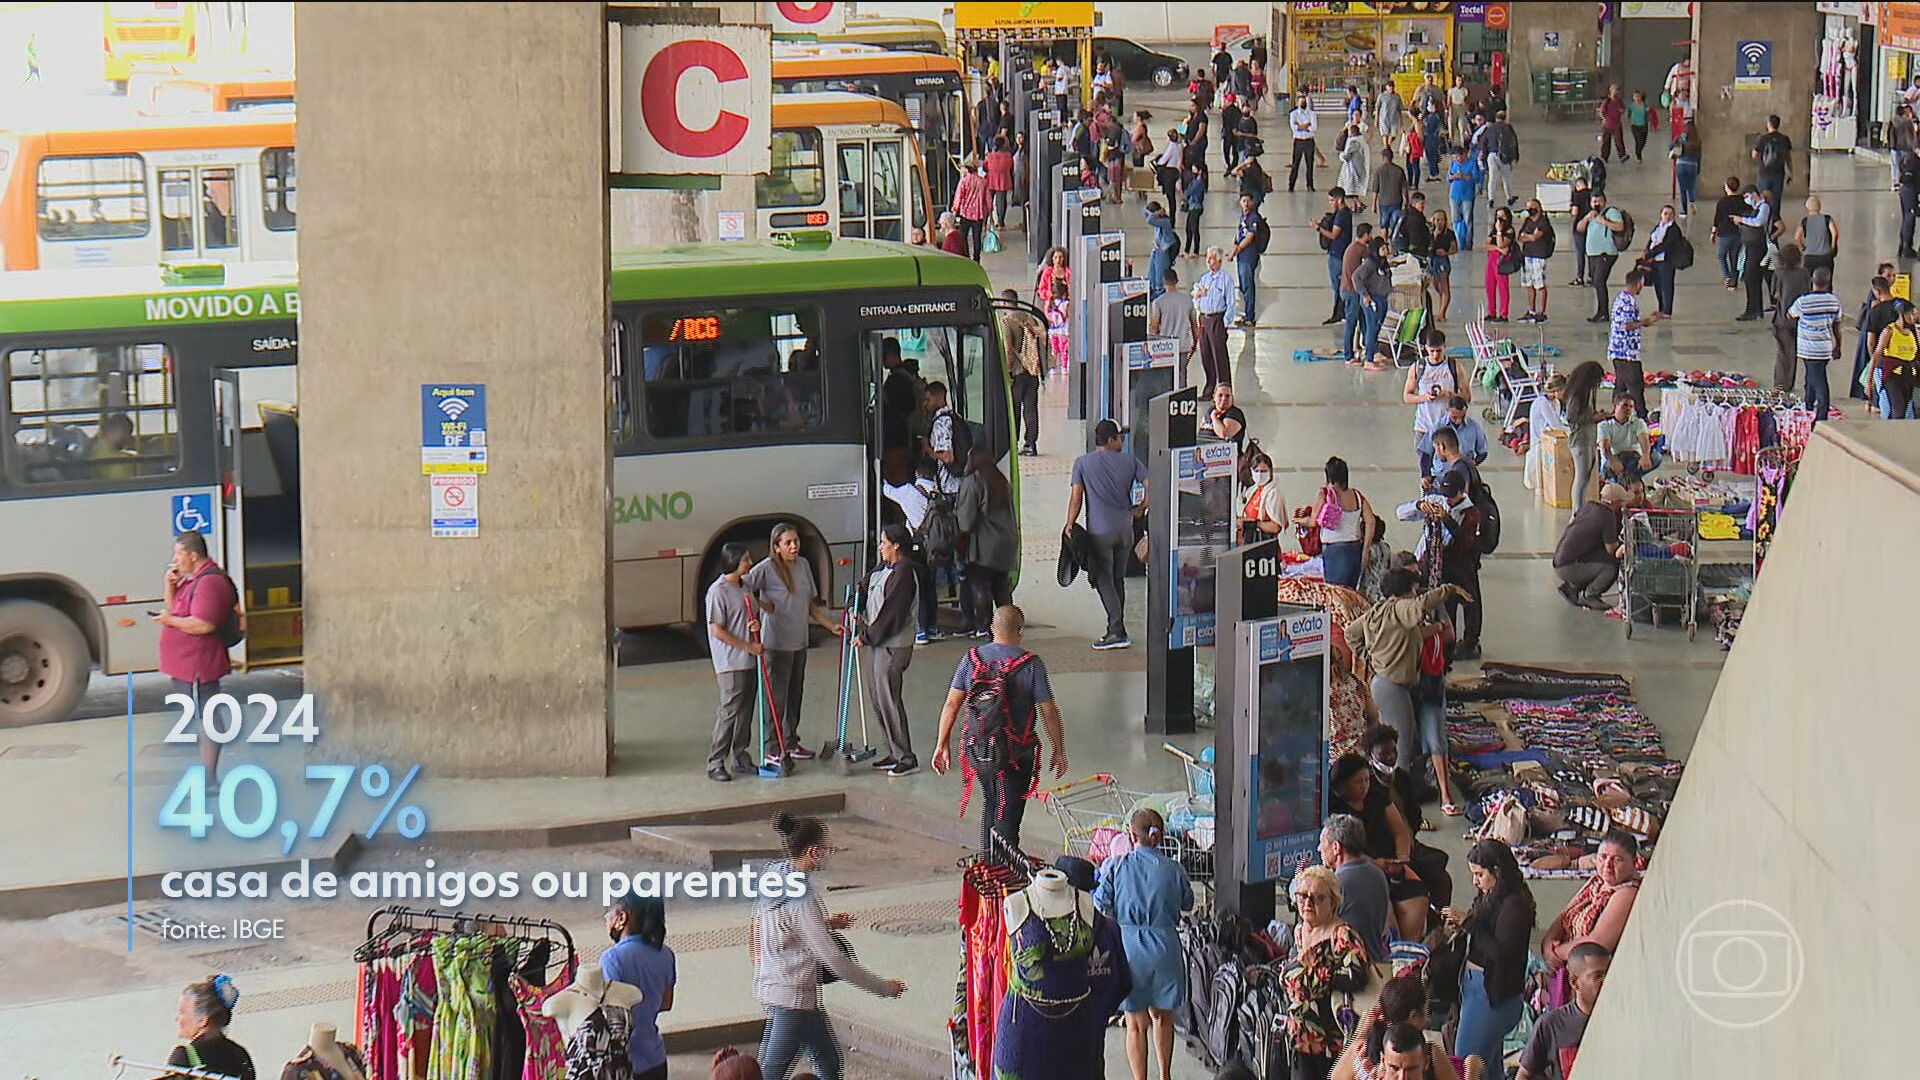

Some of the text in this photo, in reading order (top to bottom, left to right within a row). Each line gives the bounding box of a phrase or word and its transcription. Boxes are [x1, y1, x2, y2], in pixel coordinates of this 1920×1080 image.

[1460, 5, 1484, 14] Tectel
[915, 77, 945, 87] ENTRADA
[641, 40, 749, 158] C
[1048, 131, 1053, 140] C
[1062, 167, 1068, 176] C
[1082, 206, 1089, 217] C
[1101, 250, 1120, 262] C 04
[144, 293, 254, 321] MOVIDO
[259, 292, 280, 315] A
[860, 302, 956, 316] ENTRADA ENTRANCE
[1124, 304, 1146, 317] C 03
[1169, 400, 1196, 415] C 02
[444, 435, 464, 446] DF
[1205, 446, 1231, 459] exato
[1245, 557, 1276, 578] C 01
[1292, 616, 1323, 634] exato
[1282, 848, 1314, 868] exato
